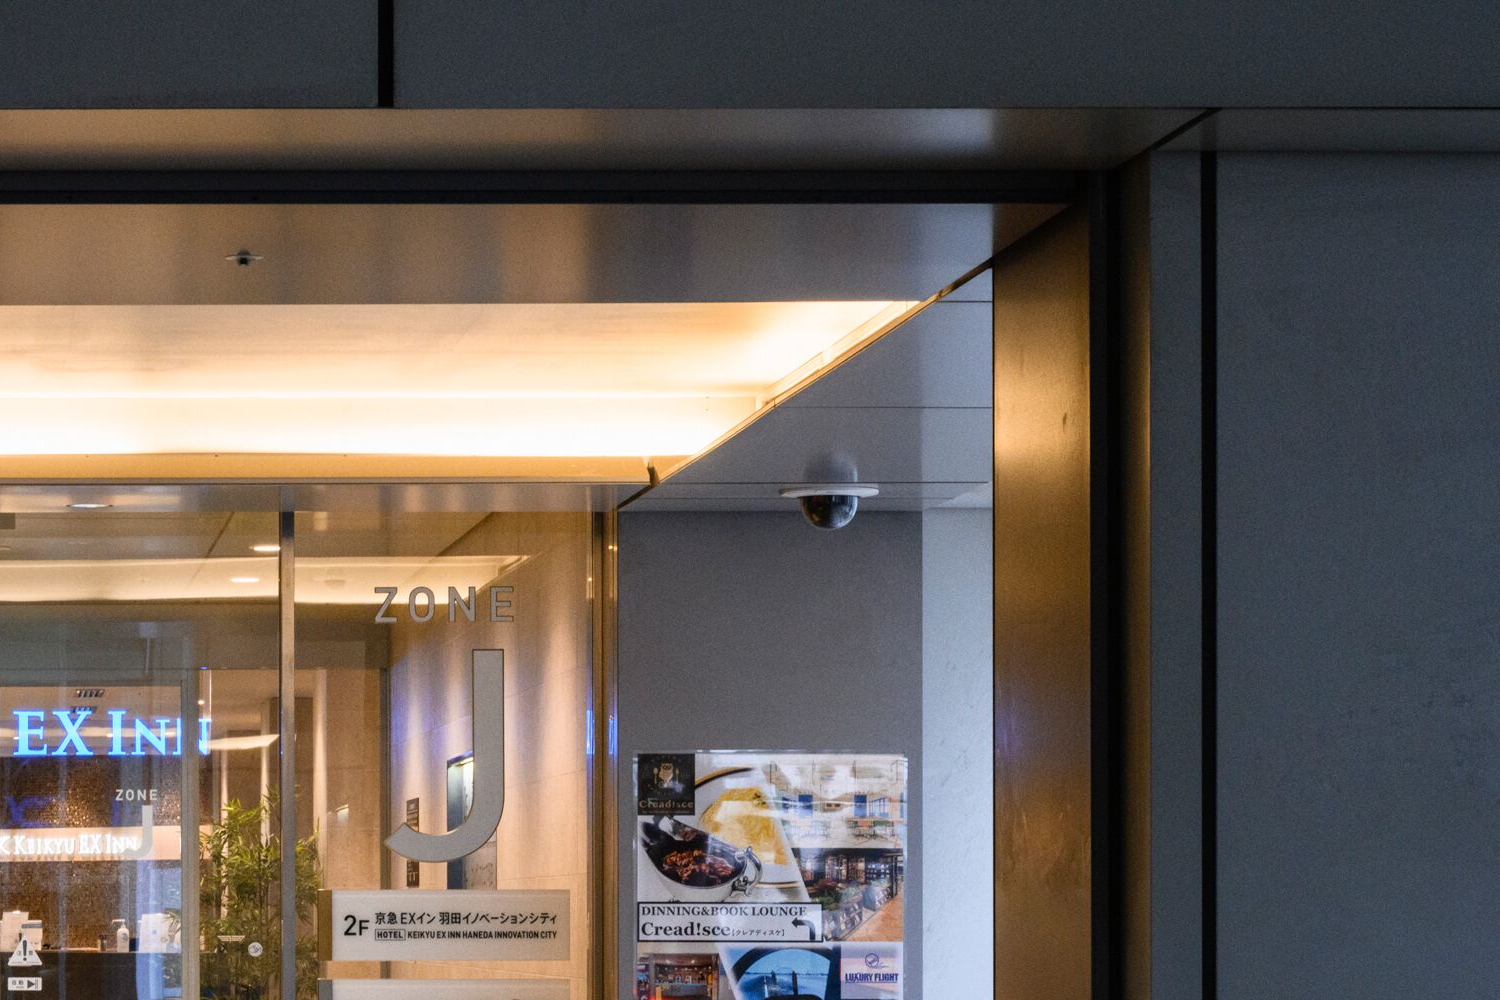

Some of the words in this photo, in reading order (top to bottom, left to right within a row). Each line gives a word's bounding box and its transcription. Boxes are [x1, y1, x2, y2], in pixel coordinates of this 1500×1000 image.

[374, 586, 514, 622] ZONE
[13, 710, 93, 755] EX
[384, 649, 504, 863] J
[116, 789, 158, 801] ZONE
[122, 805, 153, 859] J
[79, 834, 102, 854] EX
[375, 911, 398, 925] 京急
[438, 911, 557, 925] 羽田イノベーションシティ
[641, 906, 749, 917] DINNING&BOOK
[343, 914, 370, 937] 2F
[641, 921, 733, 937] Cread!sce
[376, 932, 404, 940] HOTEL
[407, 931, 436, 939] KEIKYU
[436, 931, 447, 939] EX
[448, 931, 461, 939] INN
[462, 931, 494, 939] HANEDA
[494, 931, 540, 939] INNOVATION
[540, 931, 557, 939] CITY
[845, 972, 872, 983] LUXURY
[874, 972, 899, 983] FLIGHT
